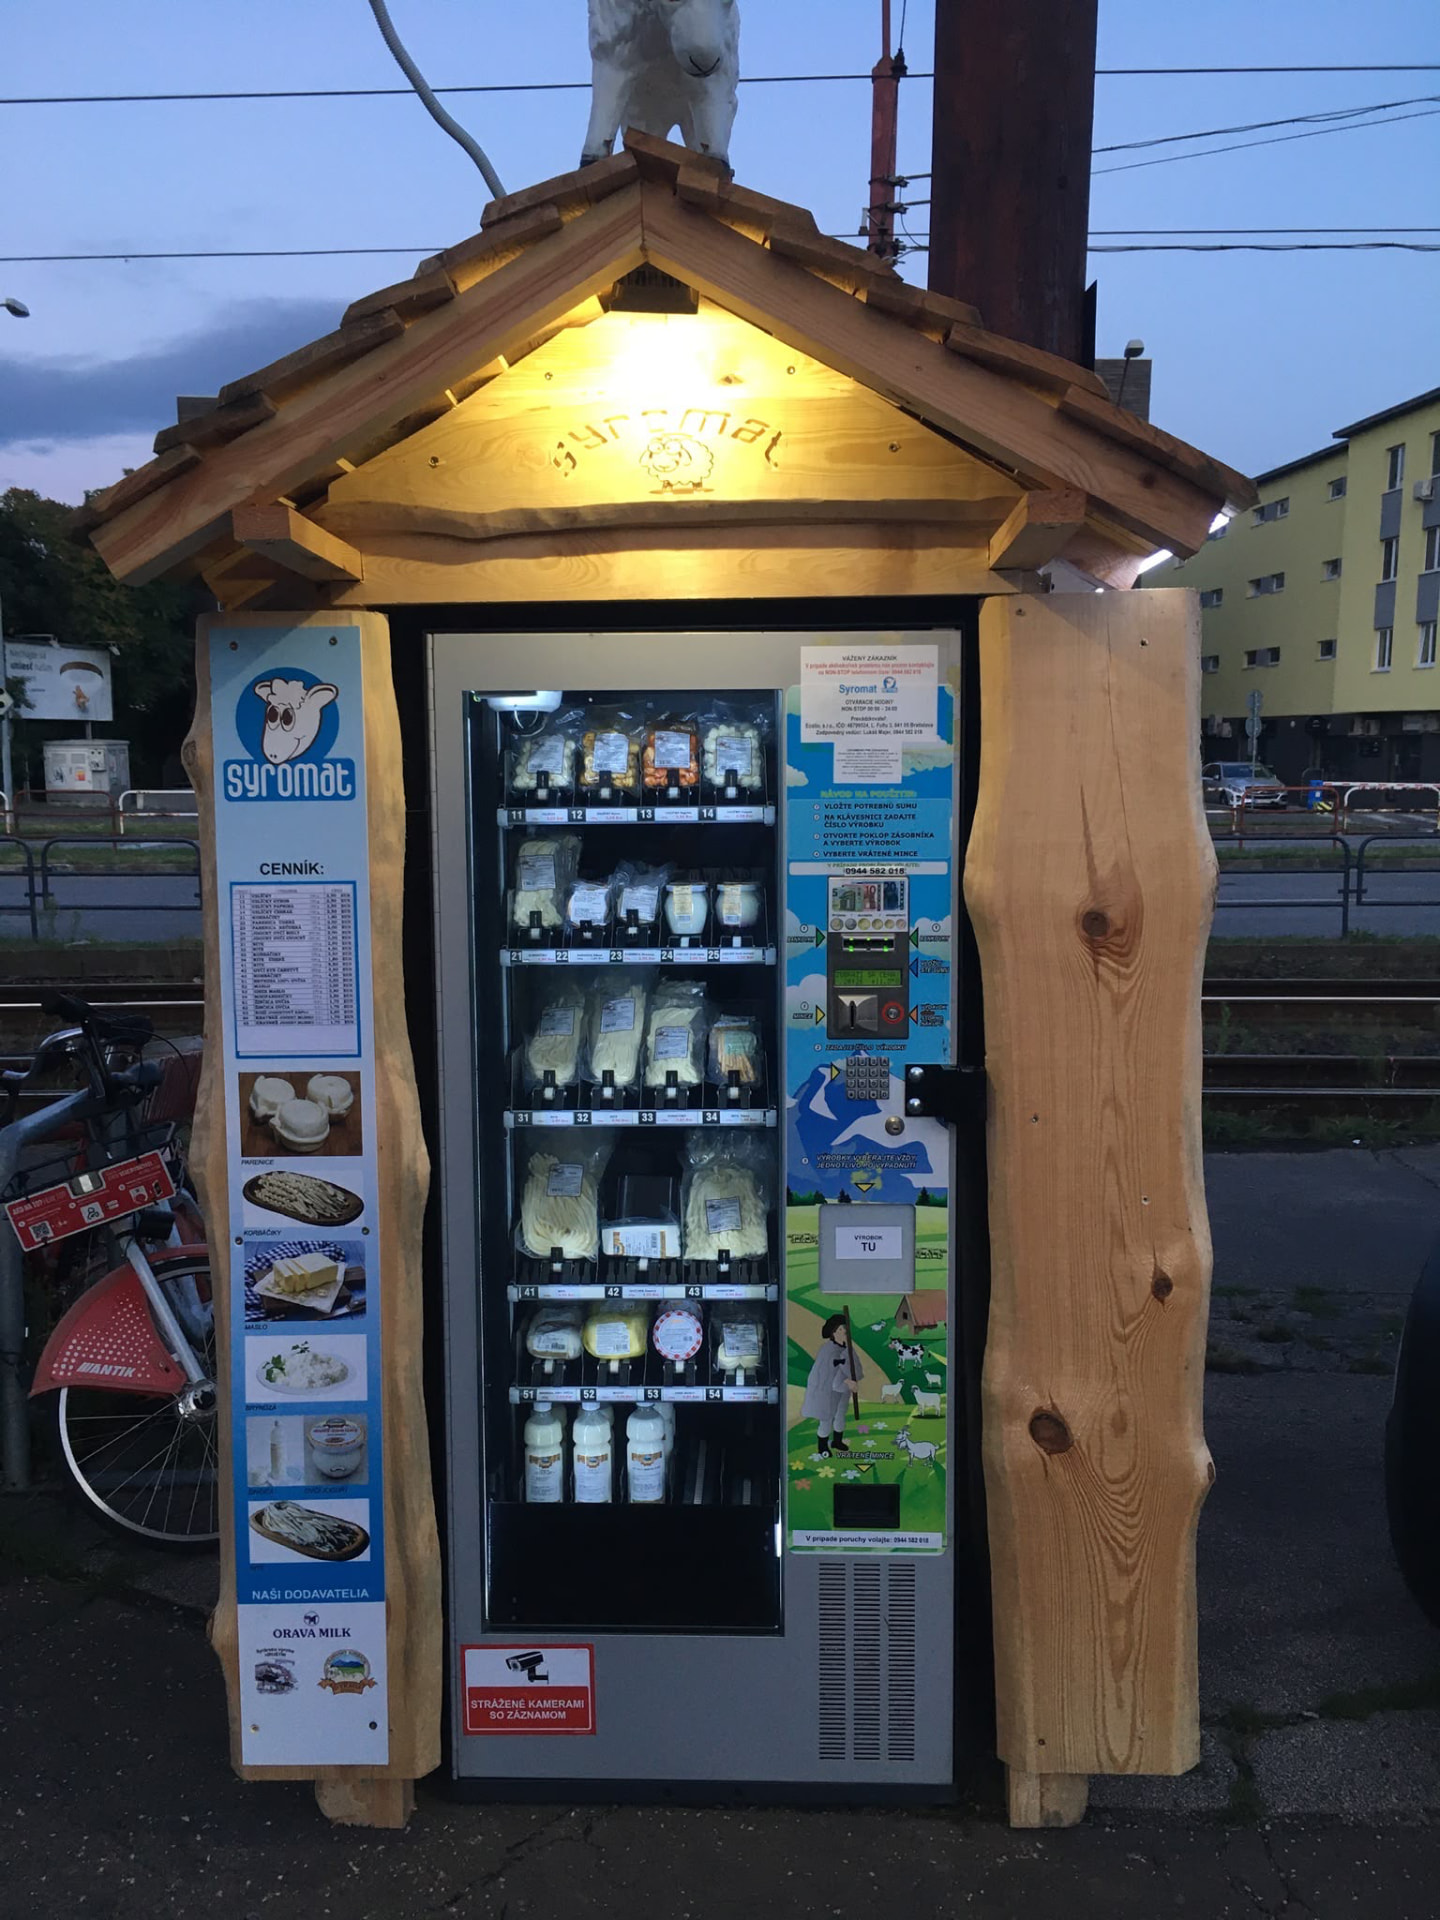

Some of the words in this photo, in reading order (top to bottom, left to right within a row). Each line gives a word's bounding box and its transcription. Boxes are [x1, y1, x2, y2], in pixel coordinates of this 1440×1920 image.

[839, 684, 877, 695] Syromat
[227, 763, 352, 797] syromat
[855, 790, 868, 798] NA
[824, 802, 852, 810] VLOŽTE
[511, 810, 522, 820] 11
[571, 810, 583, 819] 12
[641, 809, 651, 818] 13
[702, 808, 713, 818] 14
[824, 820, 847, 828] ČÍSLO
[848, 820, 884, 828] VÝROBKU
[891, 831, 935, 839] ZÁSOBNÍKA
[865, 838, 901, 846] VÝROBOK
[259, 860, 325, 876] CENNÍK:
[511, 952, 522, 961] 21
[556, 951, 568, 961] 22
[610, 951, 622, 961] 23
[661, 949, 673, 959] 24
[708, 949, 719, 959] 25
[518, 1113, 529, 1122] 31
[577, 1113, 588, 1122] 32
[641, 1113, 653, 1121] 33
[706, 1112, 717, 1121] 34
[816, 1152, 851, 1160] VÝROBKY
[861, 1242, 876, 1251] TU
[524, 1288, 535, 1296] 41
[607, 1287, 619, 1296] 42
[688, 1287, 699, 1296] 43
[90, 1363, 137, 1377] ANTIK
[523, 1390, 533, 1399] 51
[583, 1389, 595, 1399] 52
[647, 1389, 658, 1398] 53
[709, 1389, 720, 1399] 54
[252, 1589, 281, 1600] NAŠI
[284, 1588, 369, 1600] DODAVATELIA
[272, 1628, 316, 1638] ORAVA
[319, 1628, 351, 1638] MILK
[471, 1698, 526, 1709] STRÁŽENÉ
[528, 1699, 585, 1709] KAMERAMI
[489, 1711, 504, 1720] SO
[506, 1710, 567, 1720] ZÁZNAMOM
